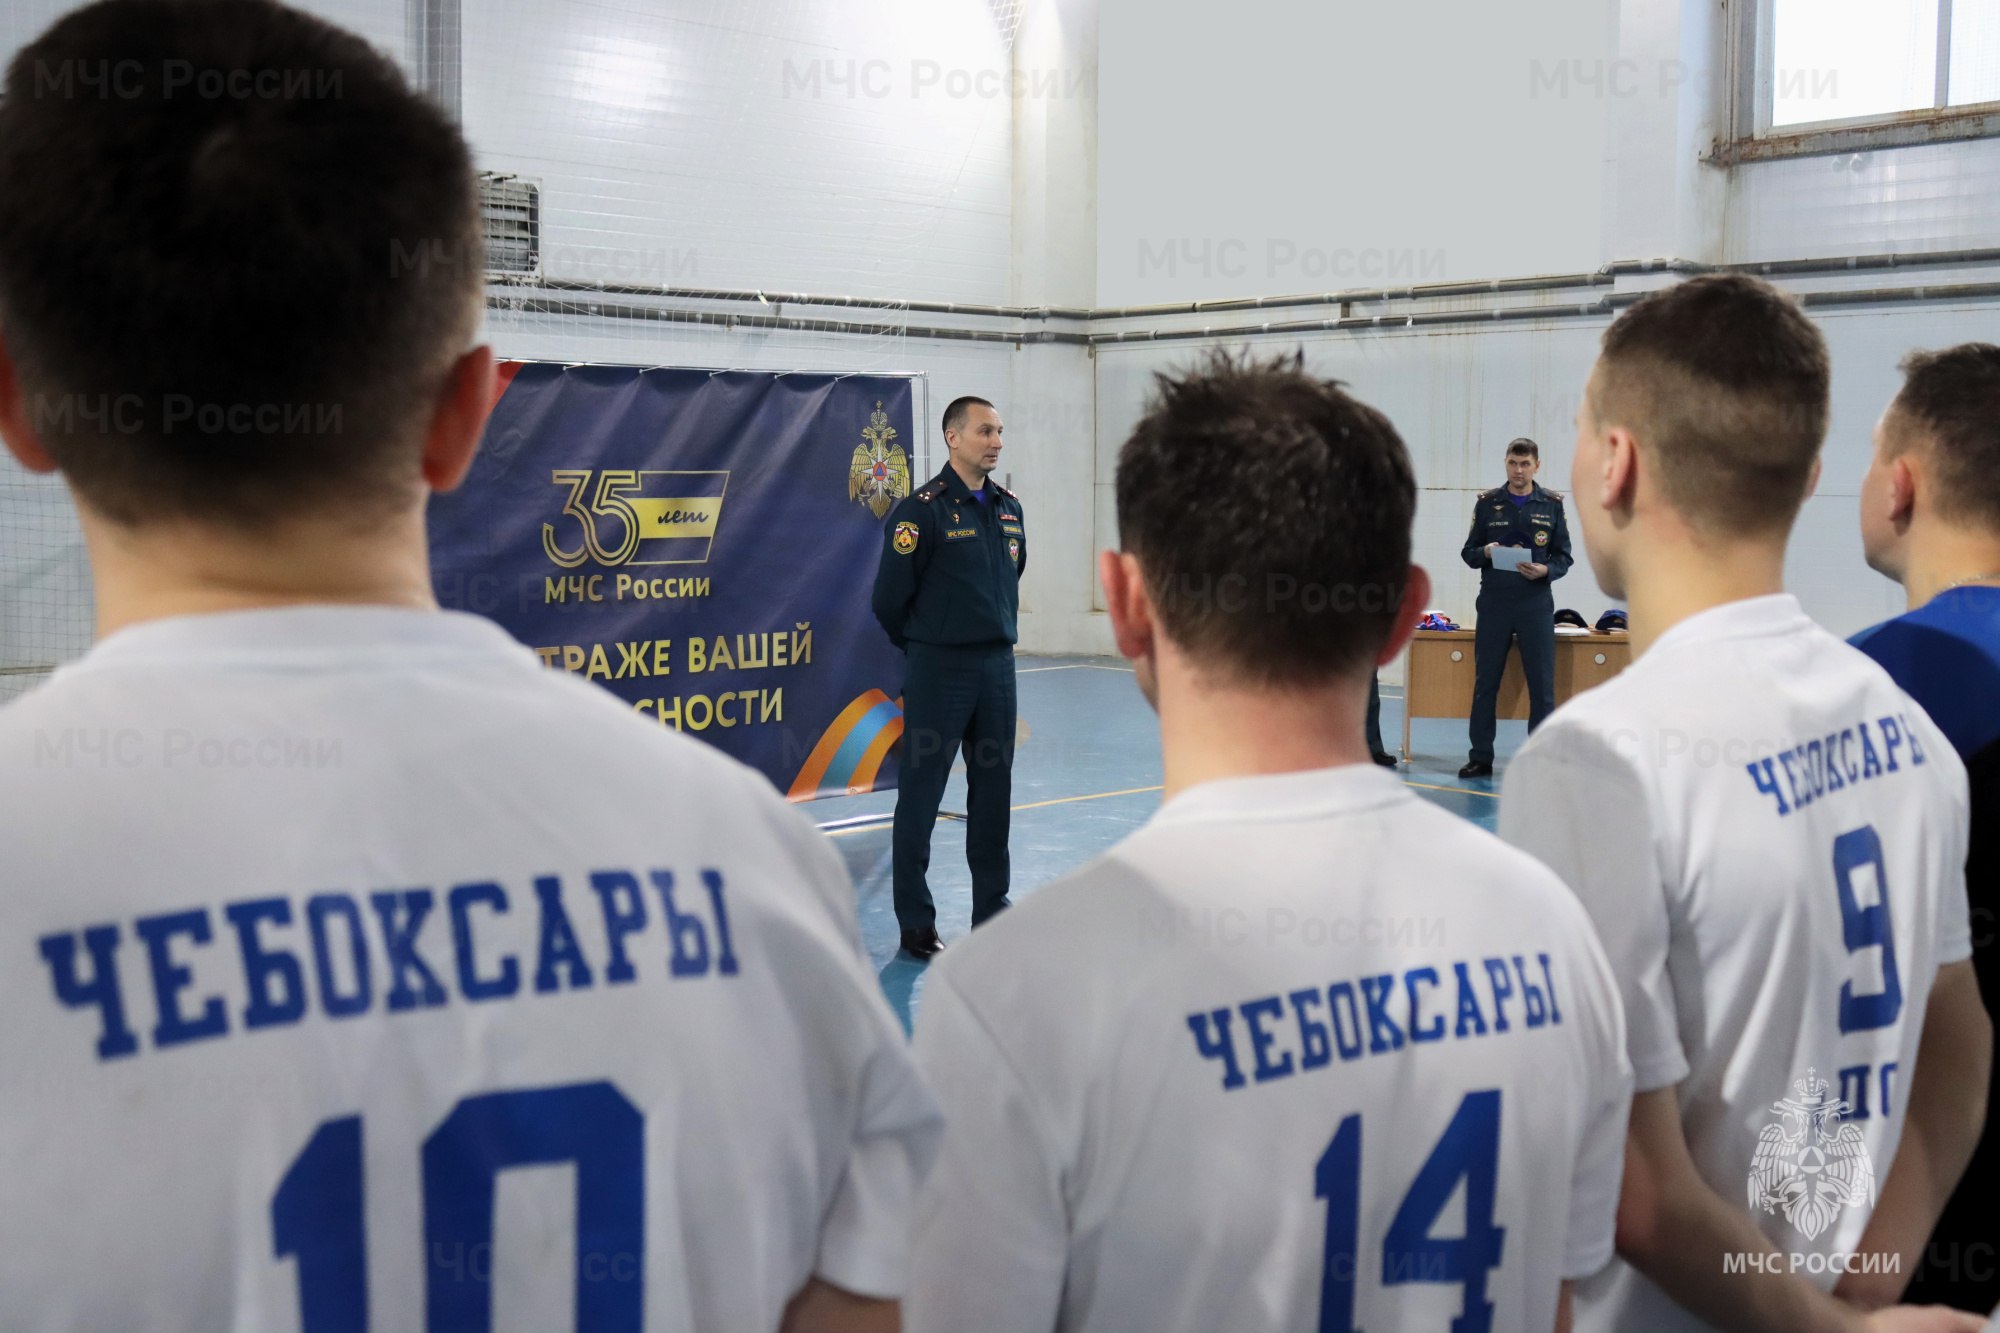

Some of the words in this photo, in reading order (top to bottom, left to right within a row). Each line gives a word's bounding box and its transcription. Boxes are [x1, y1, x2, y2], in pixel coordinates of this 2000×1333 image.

[542, 470, 636, 568] 35
[657, 509, 709, 525] лет
[545, 575, 603, 603] МЧС
[616, 573, 710, 600] России
[688, 621, 812, 673] ВАШЕЙ
[38, 869, 740, 1062] ЧЕБОКСАРЫ
[1833, 824, 1903, 1036] 9
[1186, 953, 1562, 1091] ЧЕБОКСАРЫ
[270, 1079, 646, 1333] 10
[1314, 1089, 1506, 1333] 14
